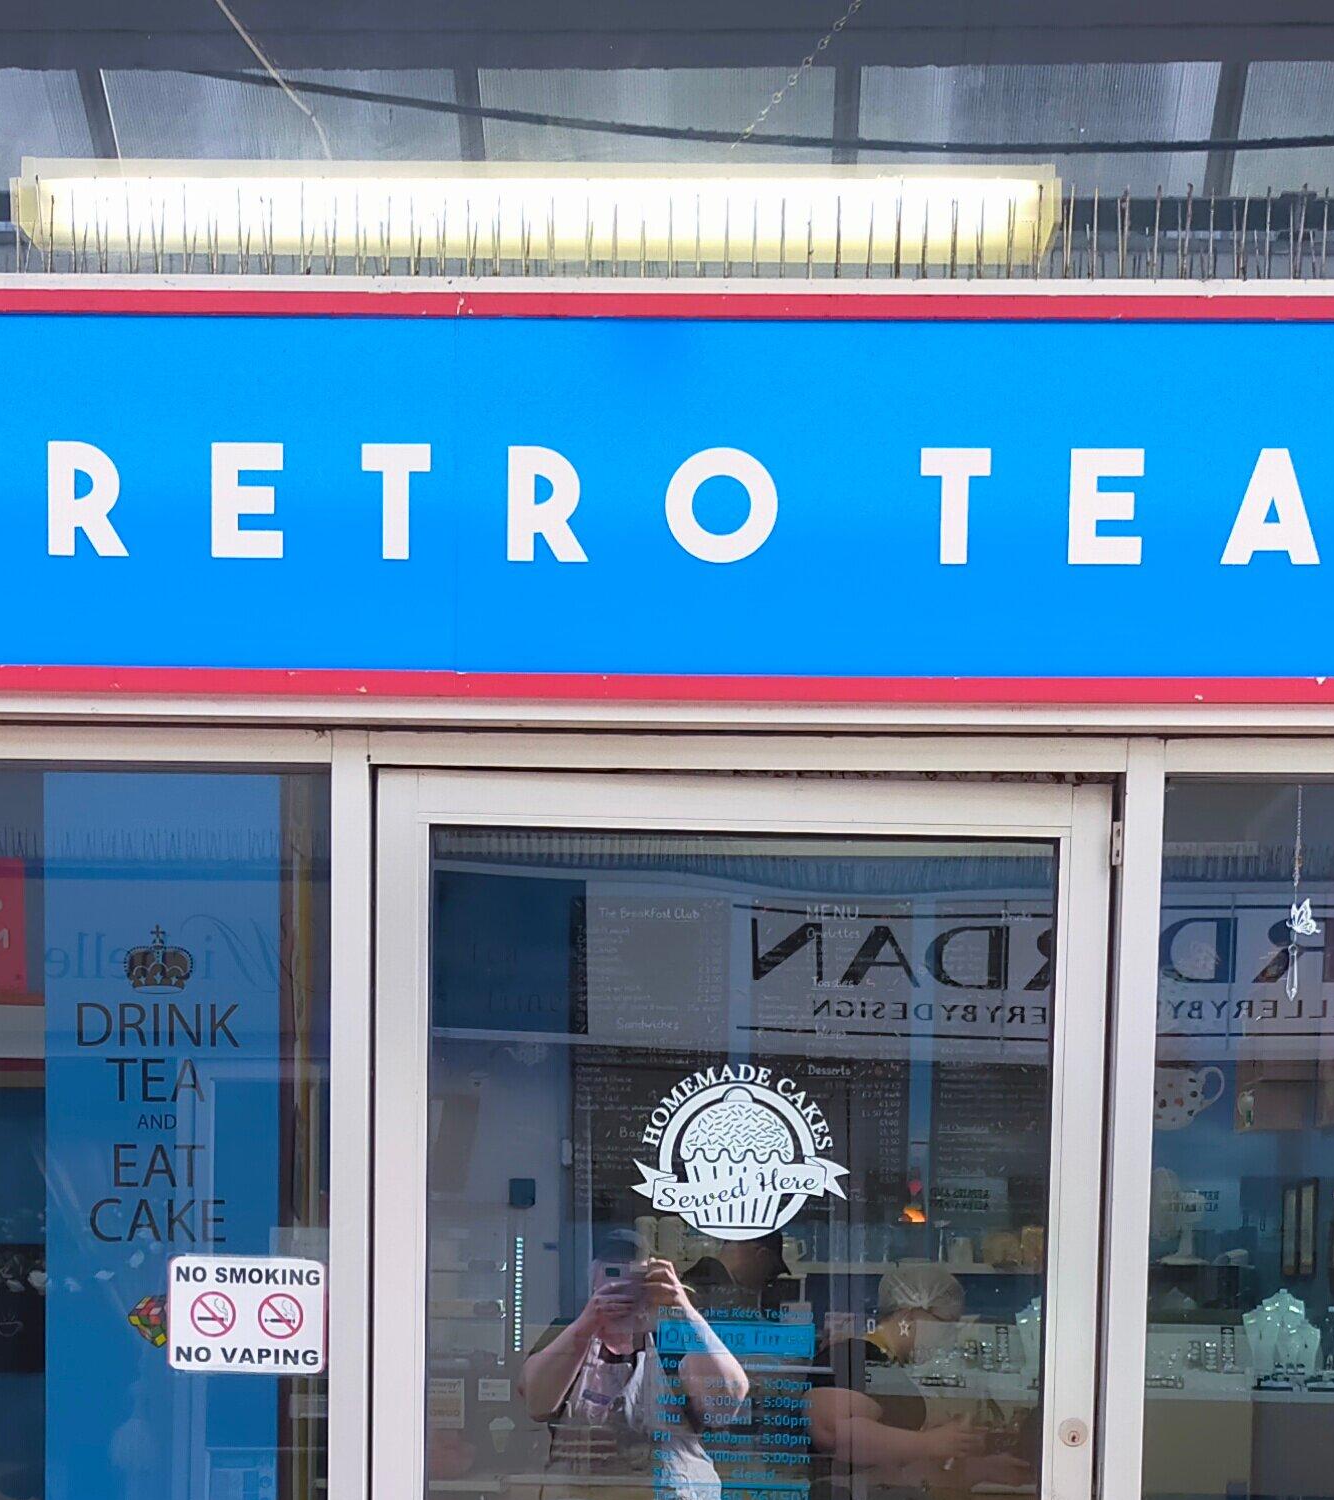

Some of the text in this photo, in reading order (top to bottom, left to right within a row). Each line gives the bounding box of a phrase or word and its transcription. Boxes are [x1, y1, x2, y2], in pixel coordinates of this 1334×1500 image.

[48, 441, 777, 562] RETRO
[921, 448, 1319, 564] TEA
[806, 904, 860, 920] MENU
[76, 1001, 240, 1049] DRINK
[808, 1064, 851, 1076] Desserts
[105, 1058, 205, 1103] TEA
[642, 1064, 773, 1147] HOMEMADE
[776, 1077, 834, 1151] CAKES
[137, 1113, 177, 1131] AND
[114, 1143, 205, 1188] EAT
[658, 1176, 749, 1208] Served
[756, 1166, 819, 1193] Here
[89, 1199, 227, 1243] CAKE
[175, 1266, 322, 1286] NO SMOKING
[732, 1308, 762, 1319] Retro
[175, 1347, 320, 1368] NO VAPING
[656, 1395, 687, 1406] Wed
[763, 1397, 812, 1411] 5:00pm
[763, 1415, 812, 1428] 5:00pm
[703, 1431, 752, 1444] 9:00am
[762, 1433, 812, 1446] 5:00pm
[762, 1452, 811, 1465] 5:00pm
